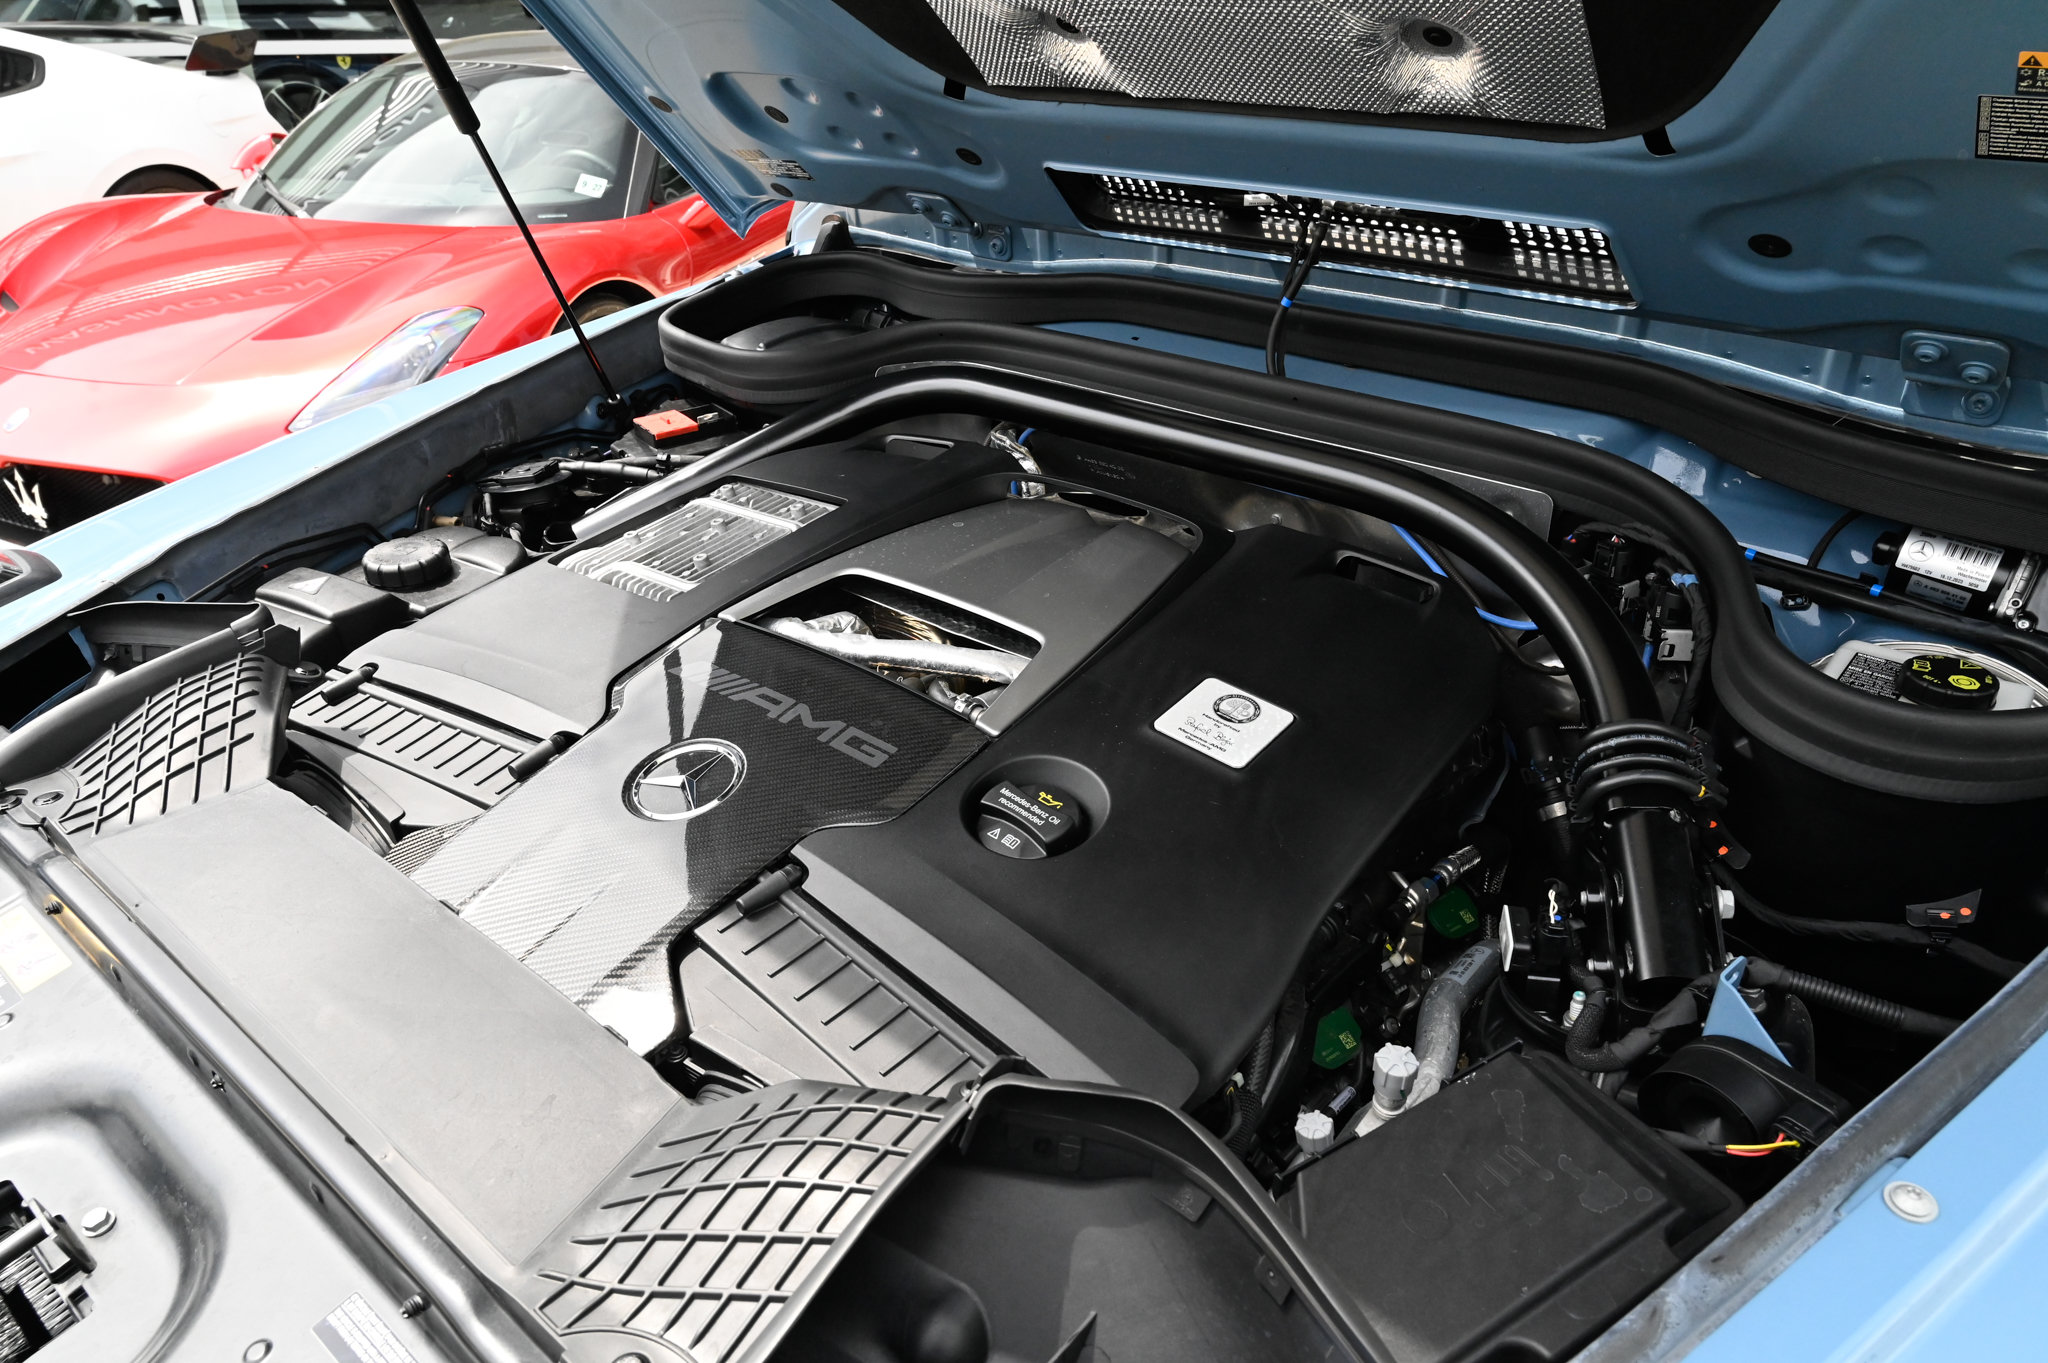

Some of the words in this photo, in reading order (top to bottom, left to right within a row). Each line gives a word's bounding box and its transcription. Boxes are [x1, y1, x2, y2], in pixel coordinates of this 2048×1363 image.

[727, 686, 898, 769] AMG
[998, 797, 1046, 826] recommended
[1000, 788, 1050, 818] Mercedes-Benz
[1048, 816, 1060, 825] Oil
